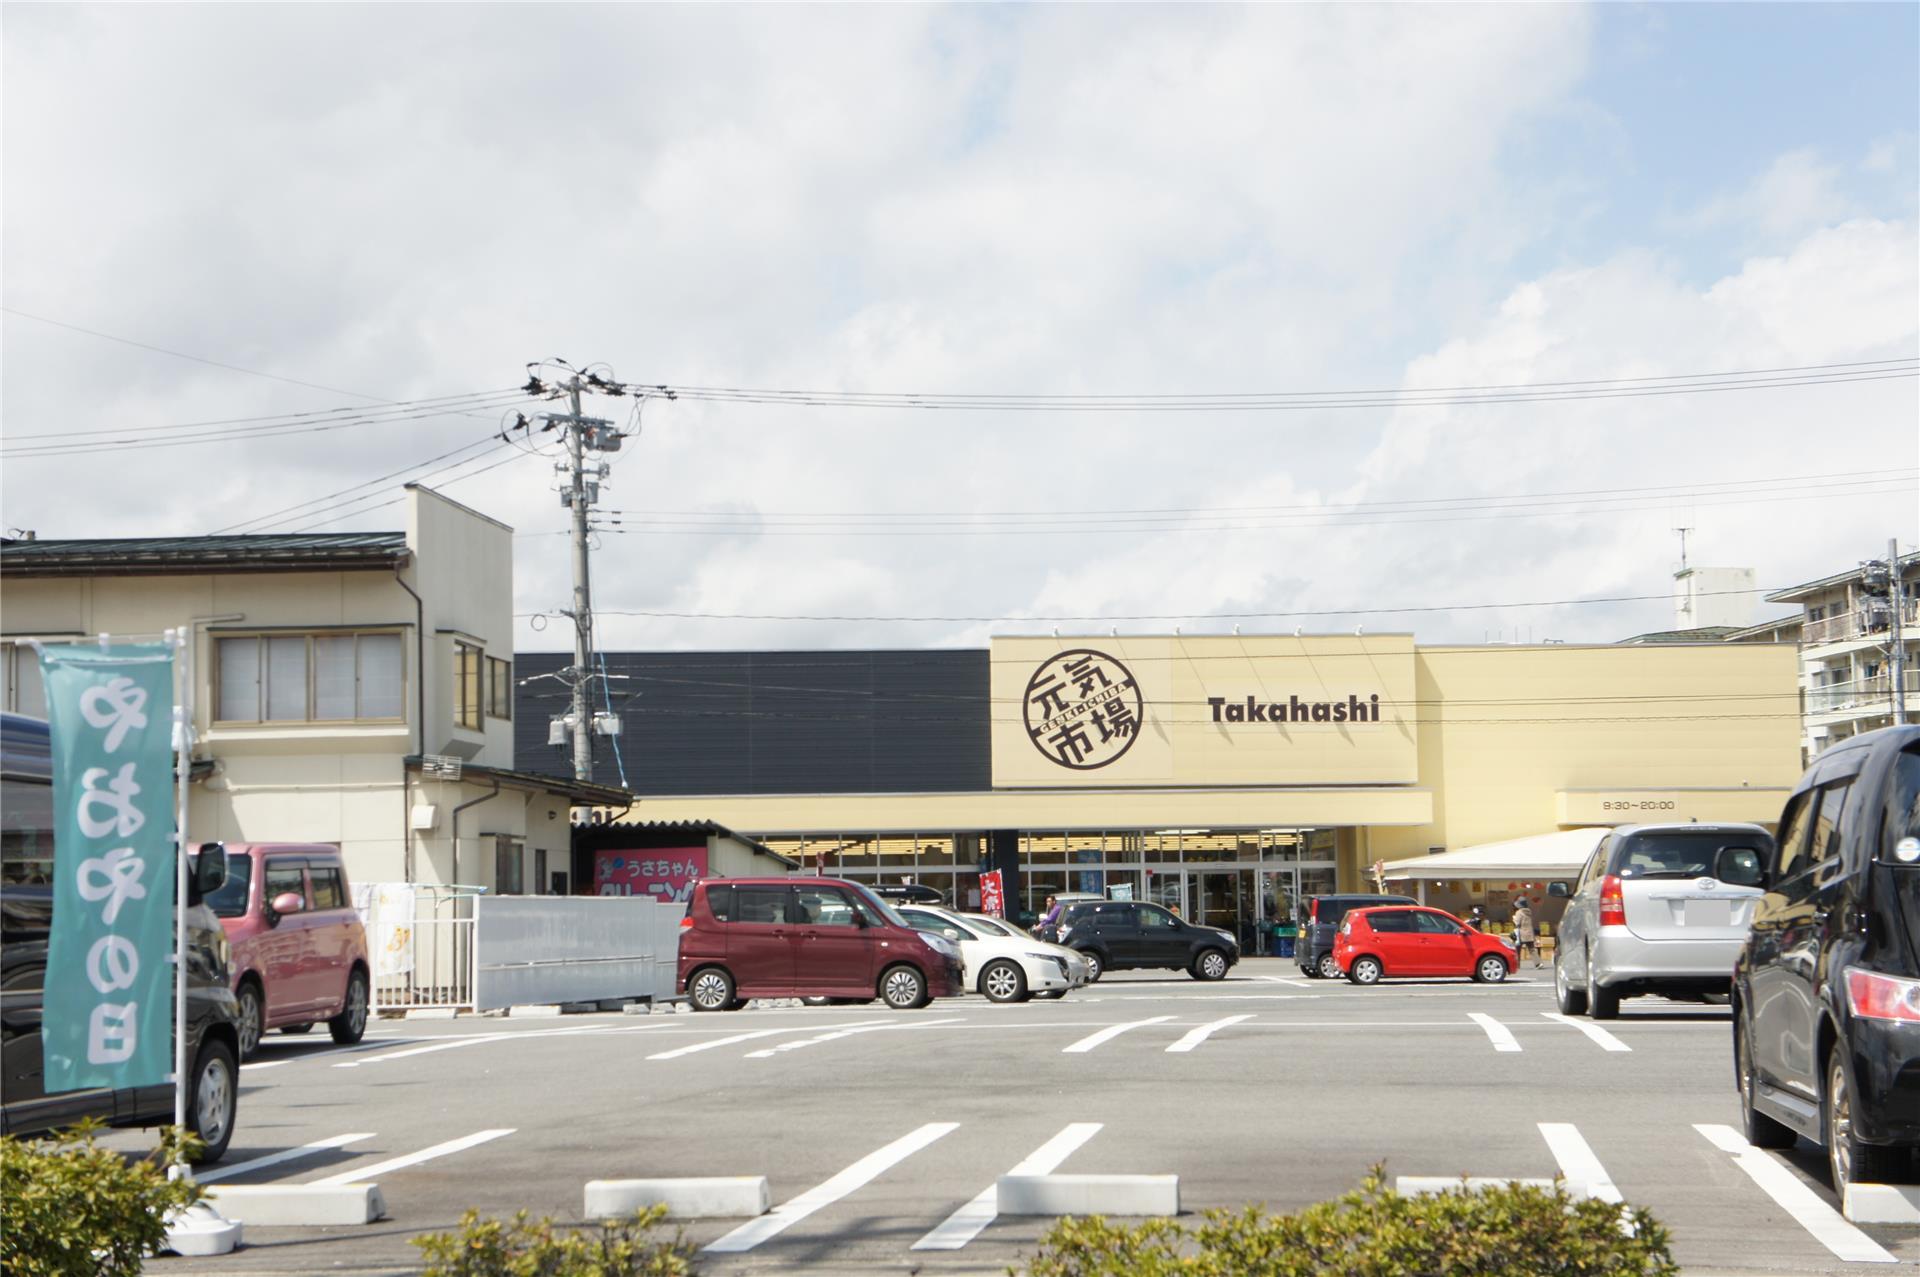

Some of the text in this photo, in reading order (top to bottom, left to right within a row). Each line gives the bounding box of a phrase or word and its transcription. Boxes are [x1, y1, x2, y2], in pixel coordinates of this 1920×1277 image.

[1027, 655, 1112, 720] 元気
[1208, 694, 1379, 722] Takahashi
[1048, 697, 1138, 764] 市場
[627, 859, 699, 877] うさちゃん
